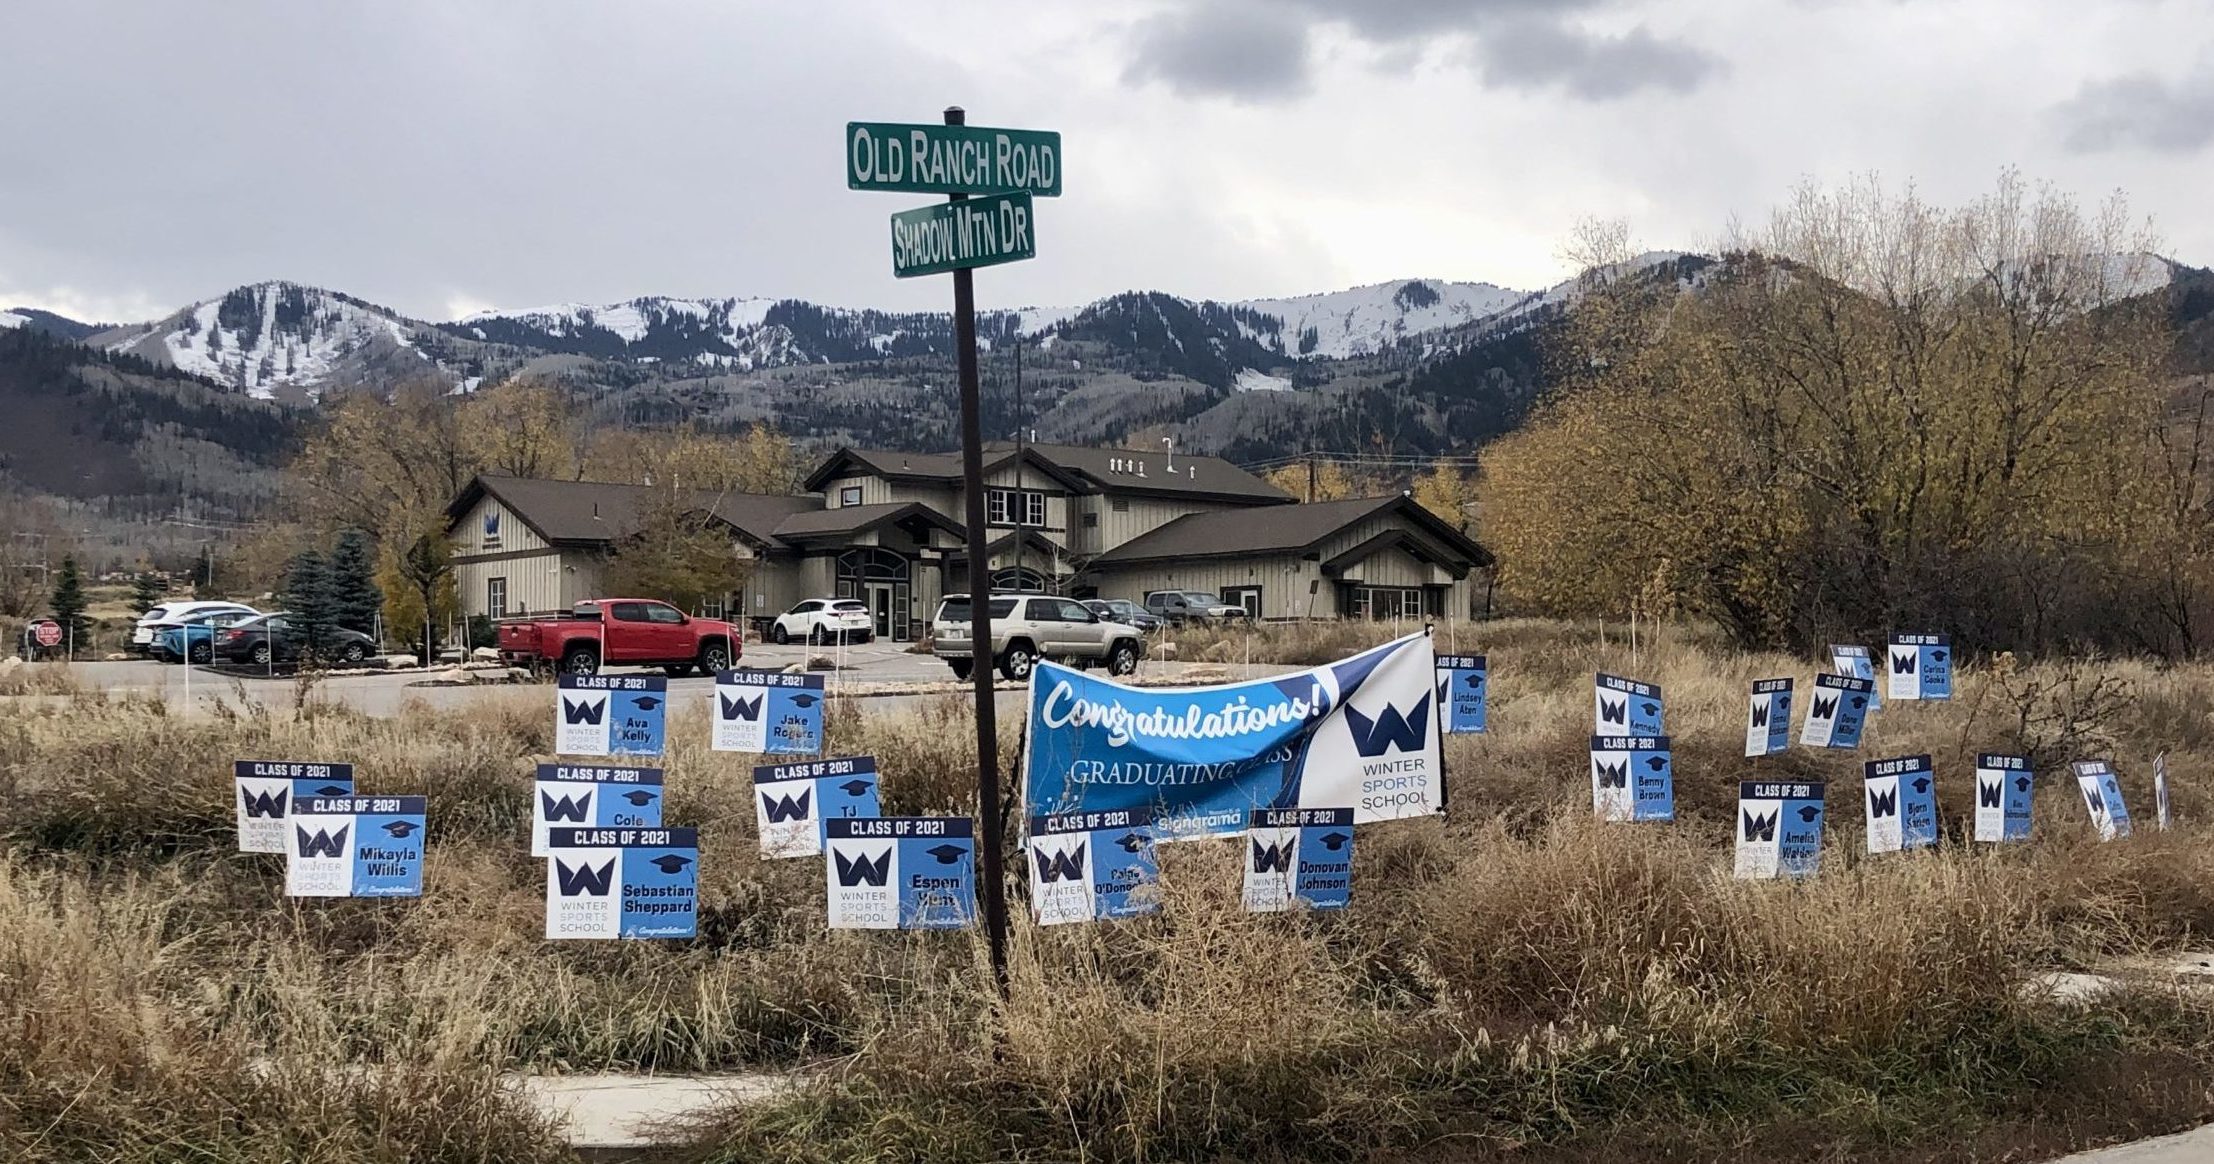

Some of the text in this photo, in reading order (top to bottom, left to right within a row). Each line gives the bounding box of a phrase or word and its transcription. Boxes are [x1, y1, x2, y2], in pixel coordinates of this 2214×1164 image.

[853, 127, 1055, 188] OLD RANCH ROAD
[894, 199, 1029, 269] SHADOW MTN DR
[39, 627, 59, 636] STOP
[1436, 657, 1450, 666] ASS
[576, 677, 646, 689] CLASS OF 2021
[733, 672, 804, 686] CLASS OF 2021
[780, 714, 808, 726] Jake
[1042, 680, 1320, 747] Congratulations!
[627, 718, 648, 728] Ava
[622, 730, 652, 743] Kelly
[1603, 738, 1655, 749] CLASS OF 2021
[254, 764, 330, 778] CLASS OF 2021
[774, 760, 854, 780] CLASS OF 2021
[1070, 760, 1235, 785] GRADUATING
[1363, 758, 1426, 776] WINTER
[1876, 758, 1920, 775] CLASS OF 2021
[556, 768, 640, 782] CLASS OF 2021
[1638, 775, 1664, 788] Benny
[1362, 774, 1428, 793] SPORTS
[1639, 790, 1665, 800] Brown
[1754, 784, 1810, 798] CLASS OF 2021
[313, 800, 400, 812] CLASS OF 2021
[1362, 791, 1429, 810] SCHOOL
[840, 804, 858, 818] TJ
[1266, 810, 1335, 825] CLASS OF 2021
[614, 814, 645, 826] Cole
[1047, 811, 1130, 832] CLASS OF 2021
[850, 820, 945, 835] CLASS OF 2021
[574, 830, 670, 845] CLASS OF 2021
[360, 848, 416, 862] Mikayla
[368, 863, 408, 876] Willis
[1300, 861, 1349, 874] Donovan
[912, 874, 960, 892] Espen
[1300, 876, 1346, 890] Johnson
[624, 884, 694, 897] Sebastian
[840, 892, 887, 900] WINTER
[561, 902, 608, 911] WINTER
[624, 900, 693, 916] Sheppard
[840, 902, 888, 912] SPORTS
[560, 912, 608, 922] SPORTS
[841, 914, 888, 922] SCHOOL
[560, 923, 608, 933] SCHOOL
